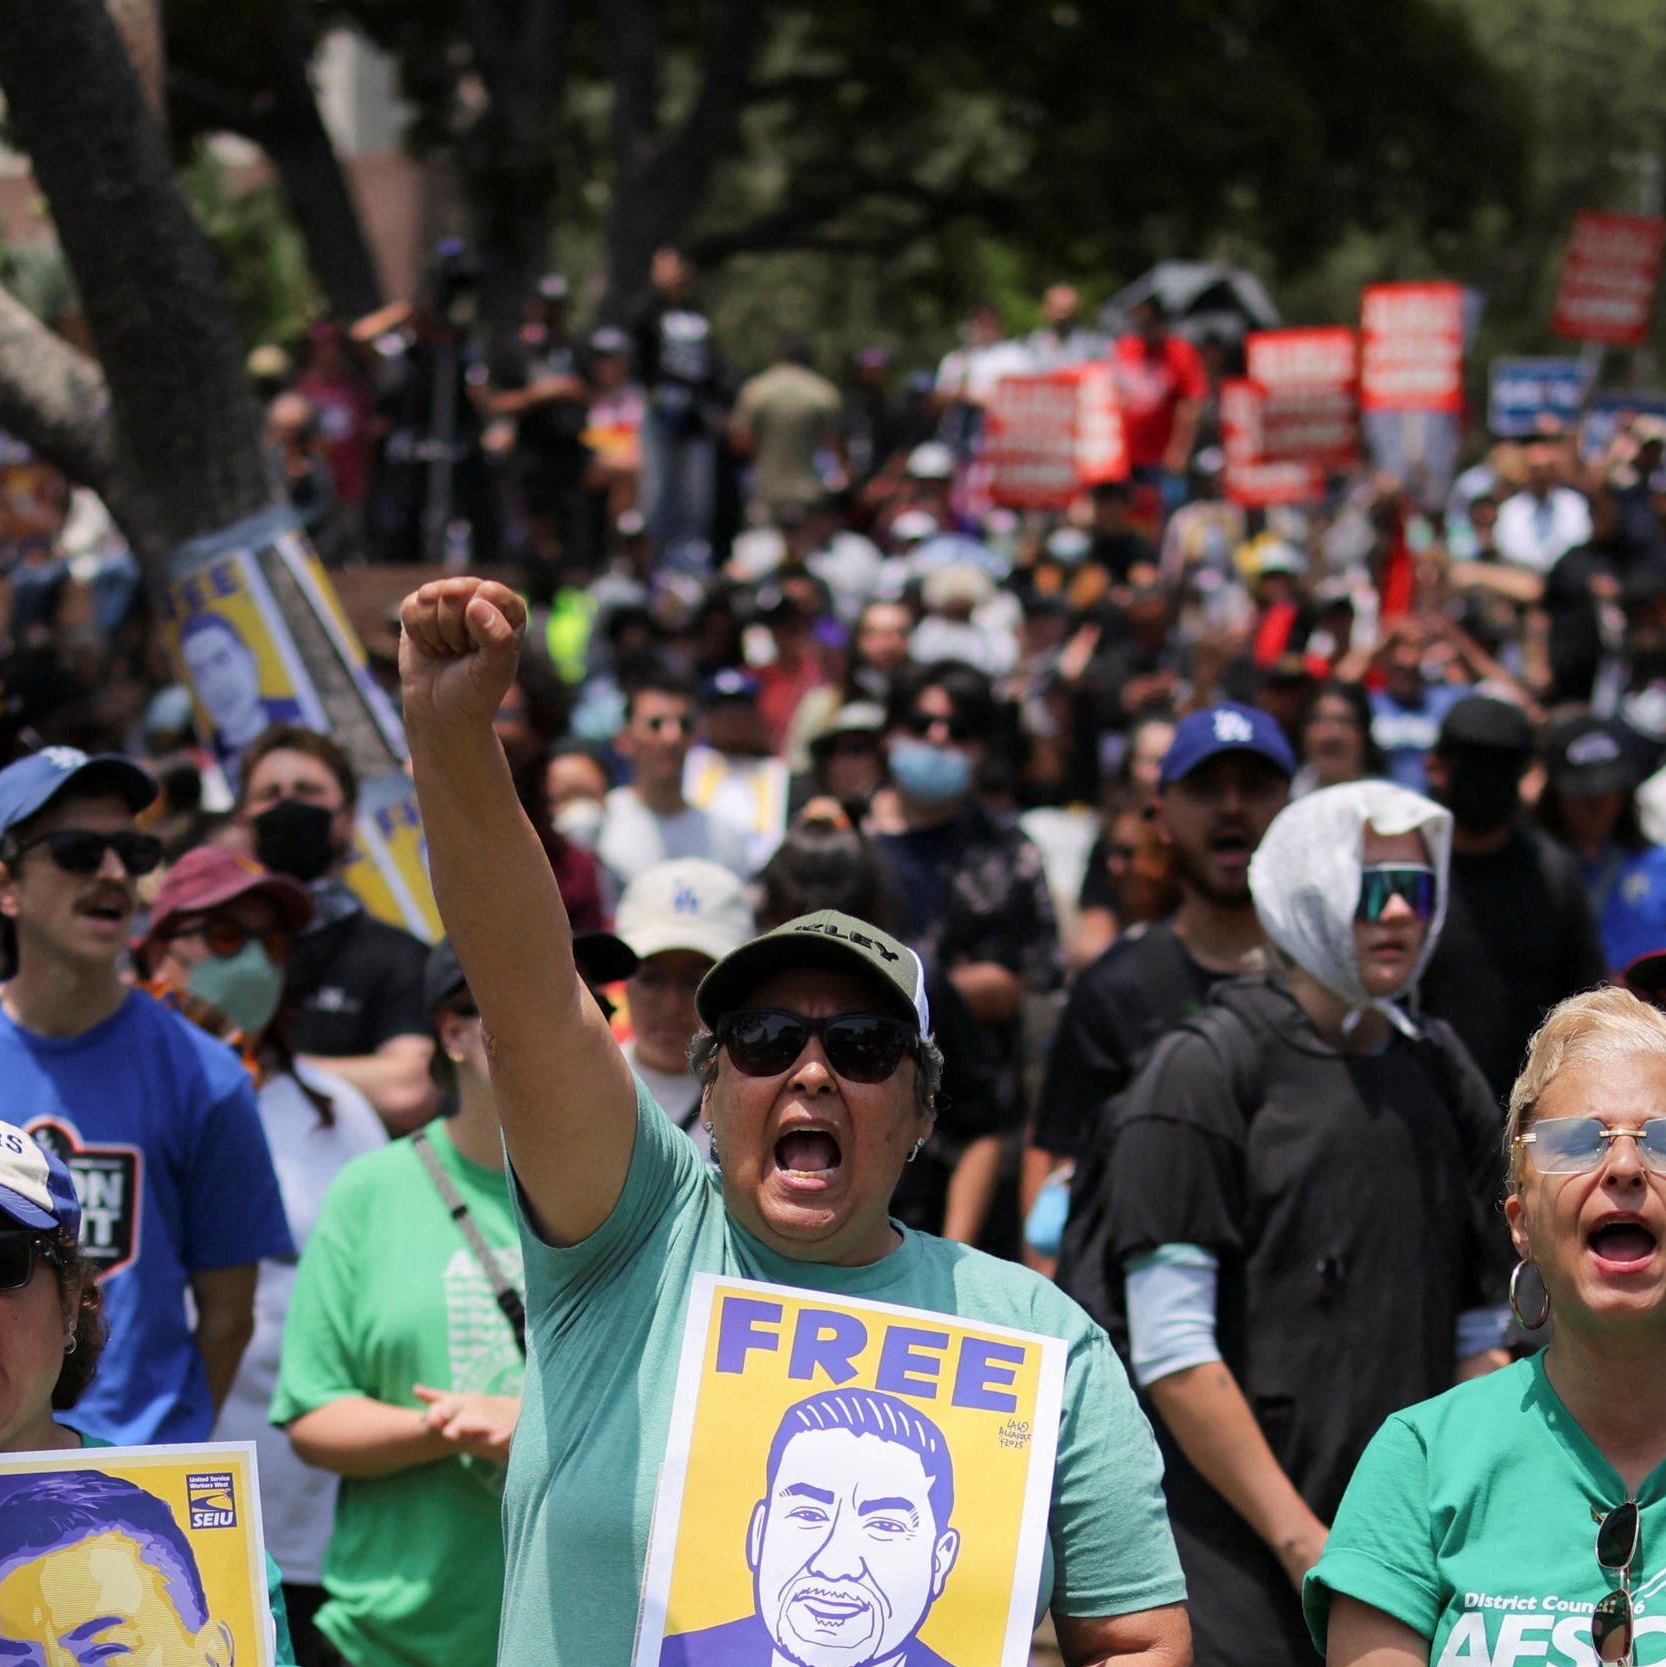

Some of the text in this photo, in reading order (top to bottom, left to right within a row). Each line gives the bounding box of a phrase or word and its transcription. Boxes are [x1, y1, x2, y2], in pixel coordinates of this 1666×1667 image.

[715, 1295, 1026, 1414] FREE
[193, 1511, 233, 1528] SEIU
[1464, 1592, 1538, 1611] District
